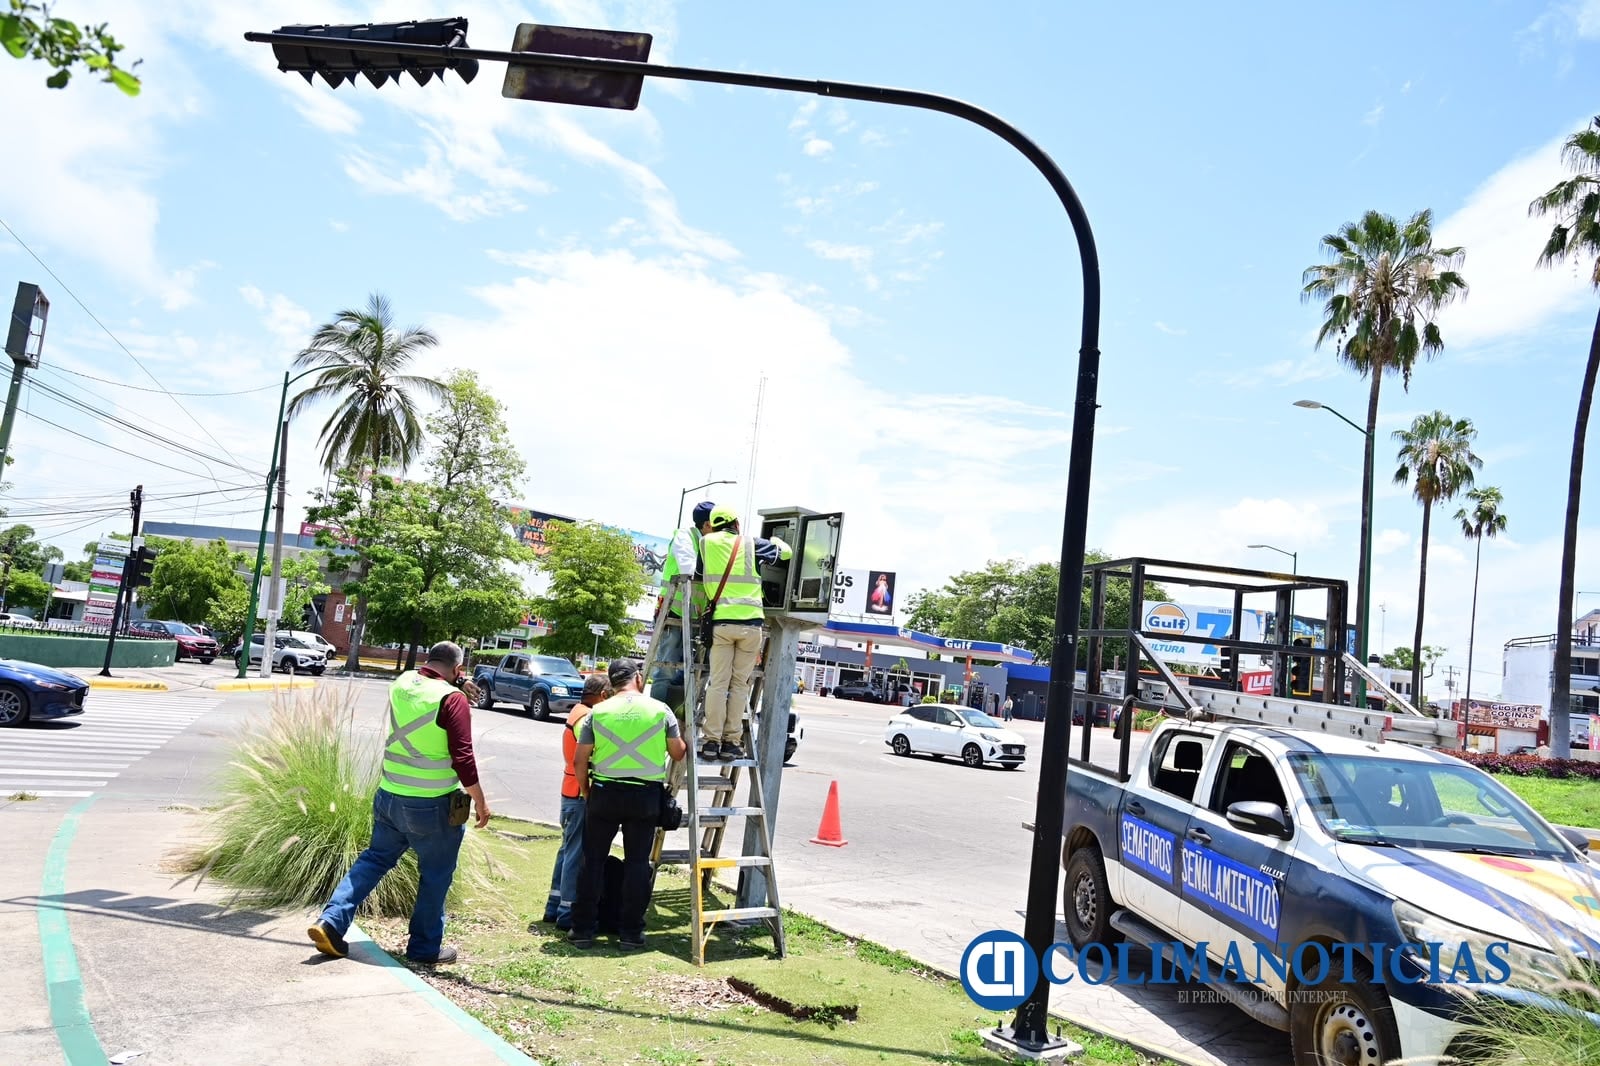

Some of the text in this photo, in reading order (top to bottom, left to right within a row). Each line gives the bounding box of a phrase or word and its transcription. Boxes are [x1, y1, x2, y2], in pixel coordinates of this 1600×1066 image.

[1149, 616, 1186, 629] Gulf
[944, 639, 973, 650] Gulf
[1491, 704, 1536, 713] CLOSETS
[1491, 711, 1536, 720] COCINAS
[1492, 719, 1507, 727] PVC
[1514, 721, 1530, 729] MDF
[1121, 821, 1171, 874] SEMAFOROS
[1259, 864, 1286, 881] HILUX
[1181, 847, 1279, 930] SEÑALAMIENTOS
